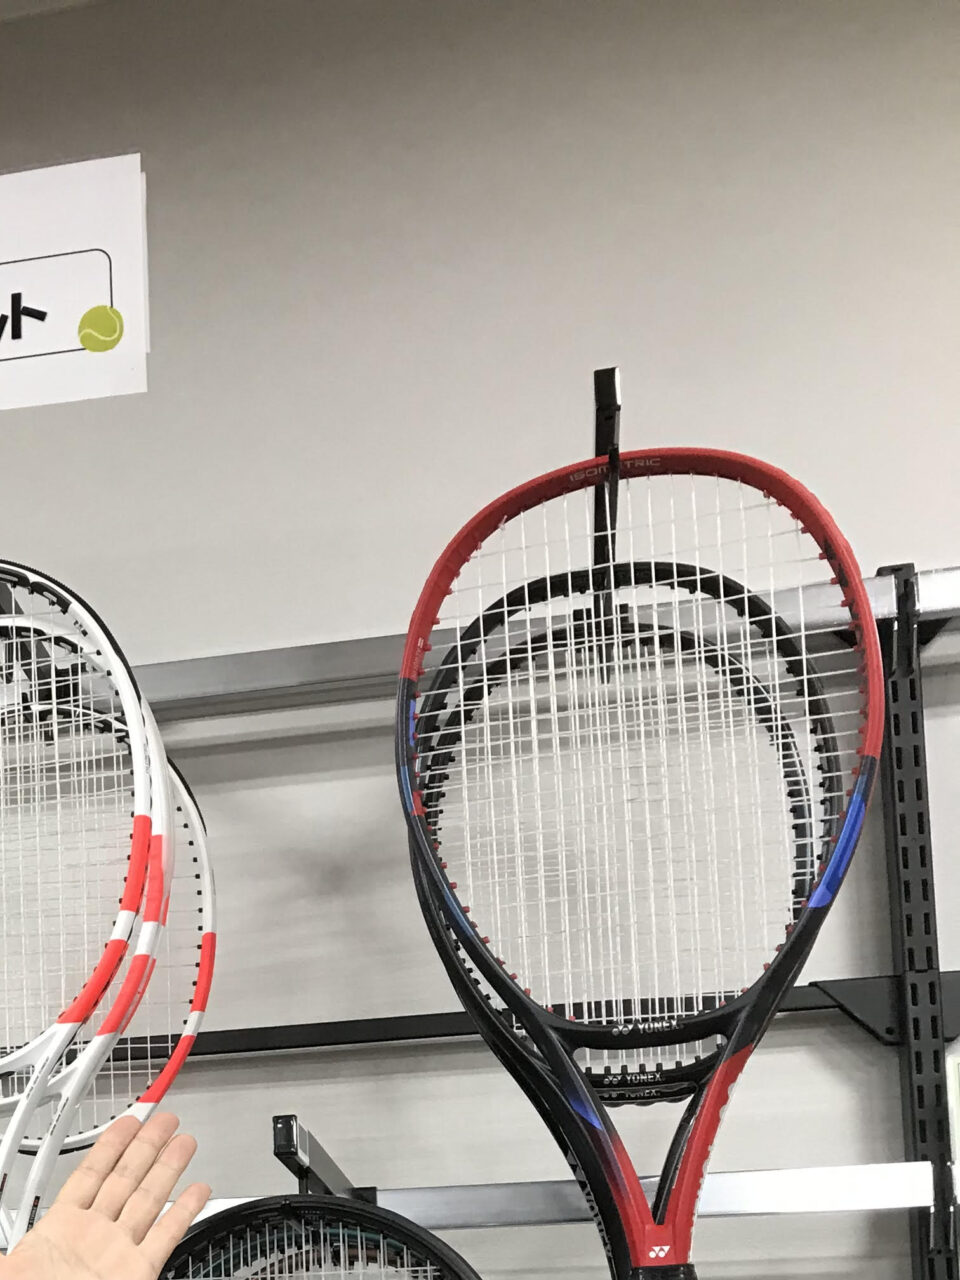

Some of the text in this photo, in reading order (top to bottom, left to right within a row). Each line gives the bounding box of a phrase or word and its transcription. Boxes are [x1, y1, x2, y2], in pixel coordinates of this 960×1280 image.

[569, 458, 661, 481] ISOMTRIC
[637, 1019, 679, 1034] YONEX
[626, 1072, 662, 1084] YONEX
